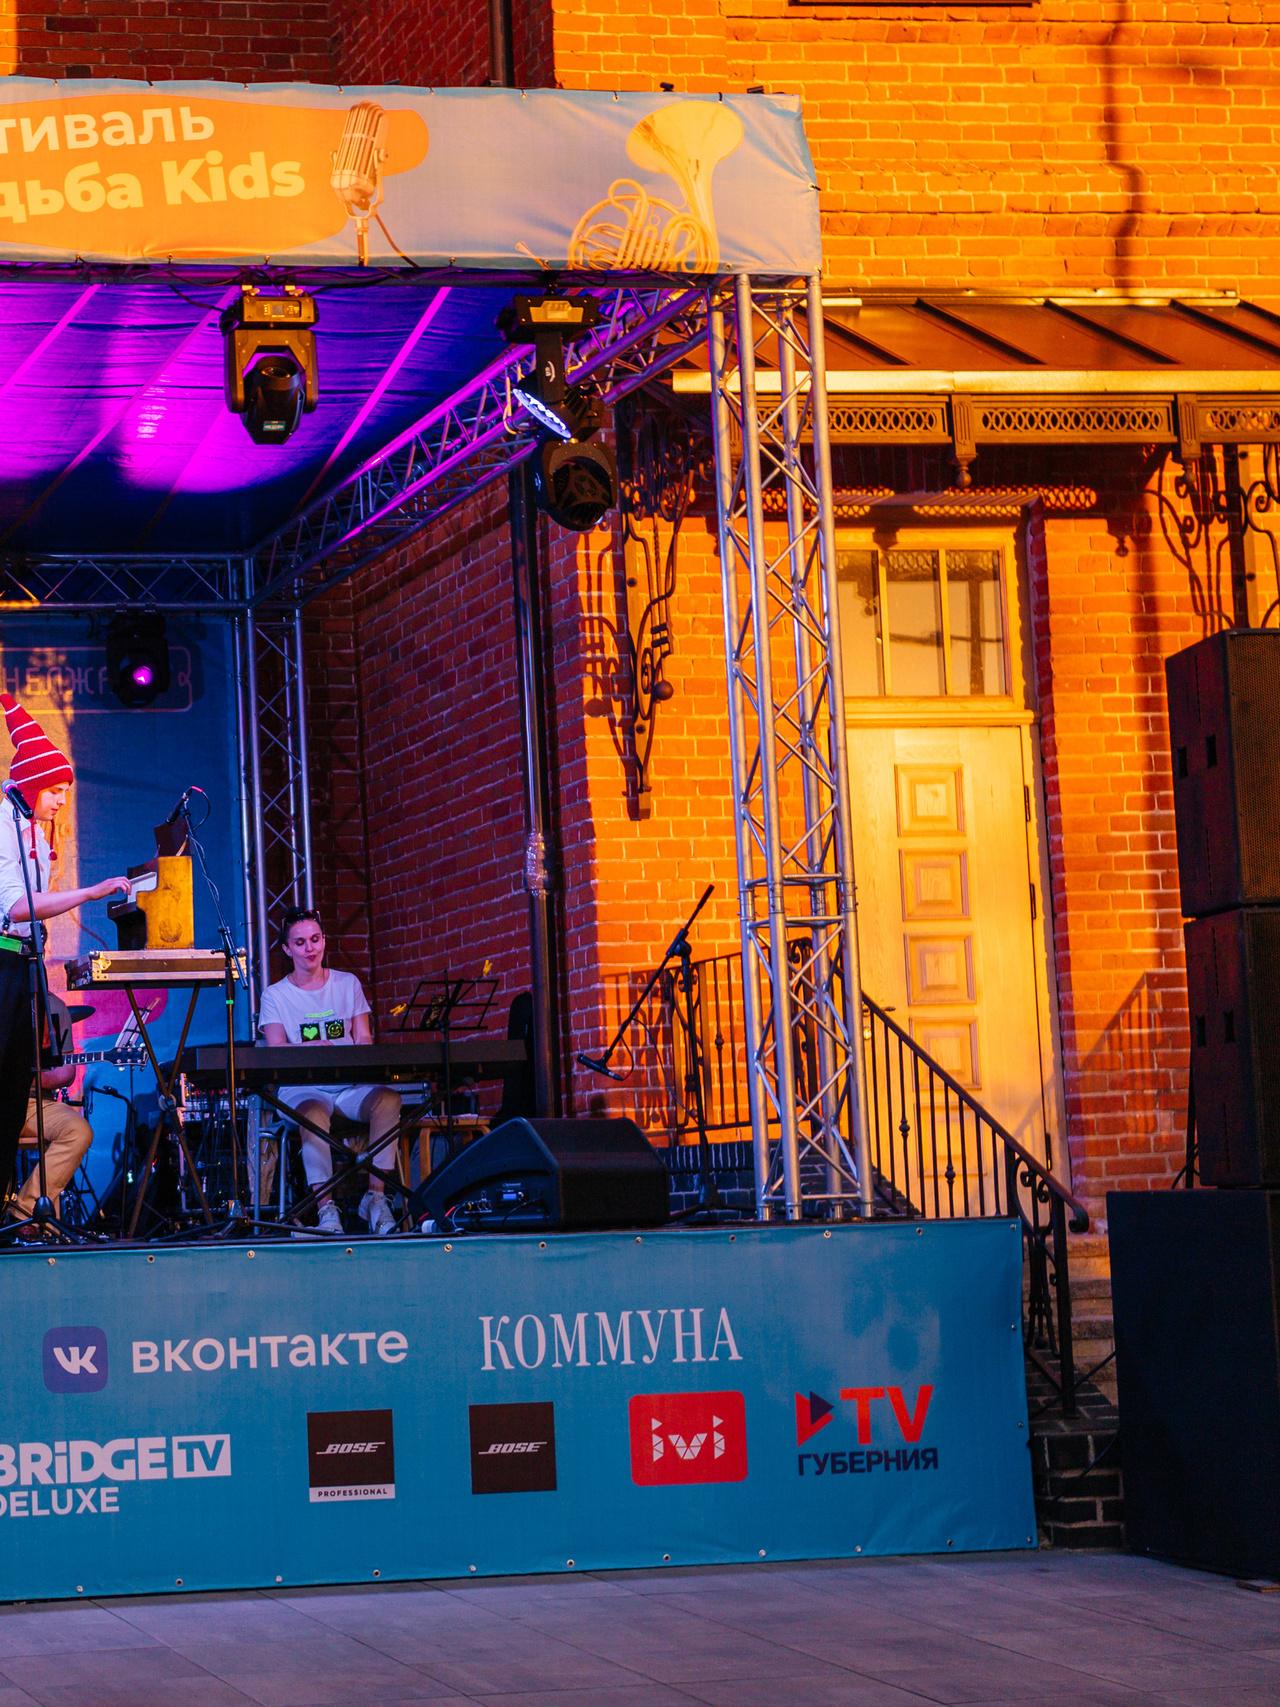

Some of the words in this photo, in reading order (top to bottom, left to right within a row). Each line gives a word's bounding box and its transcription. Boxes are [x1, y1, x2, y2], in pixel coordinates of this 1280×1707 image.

[161, 150, 306, 206] Kids
[478, 1307, 744, 1370] КОММУНА
[840, 1384, 935, 1445] TV
[316, 1441, 386, 1455] BOSE
[478, 1441, 548, 1455] BOSE
[798, 1447, 939, 1476] ГУБЕРНИЯ
[317, 1487, 388, 1498] PROFESSIONAL
